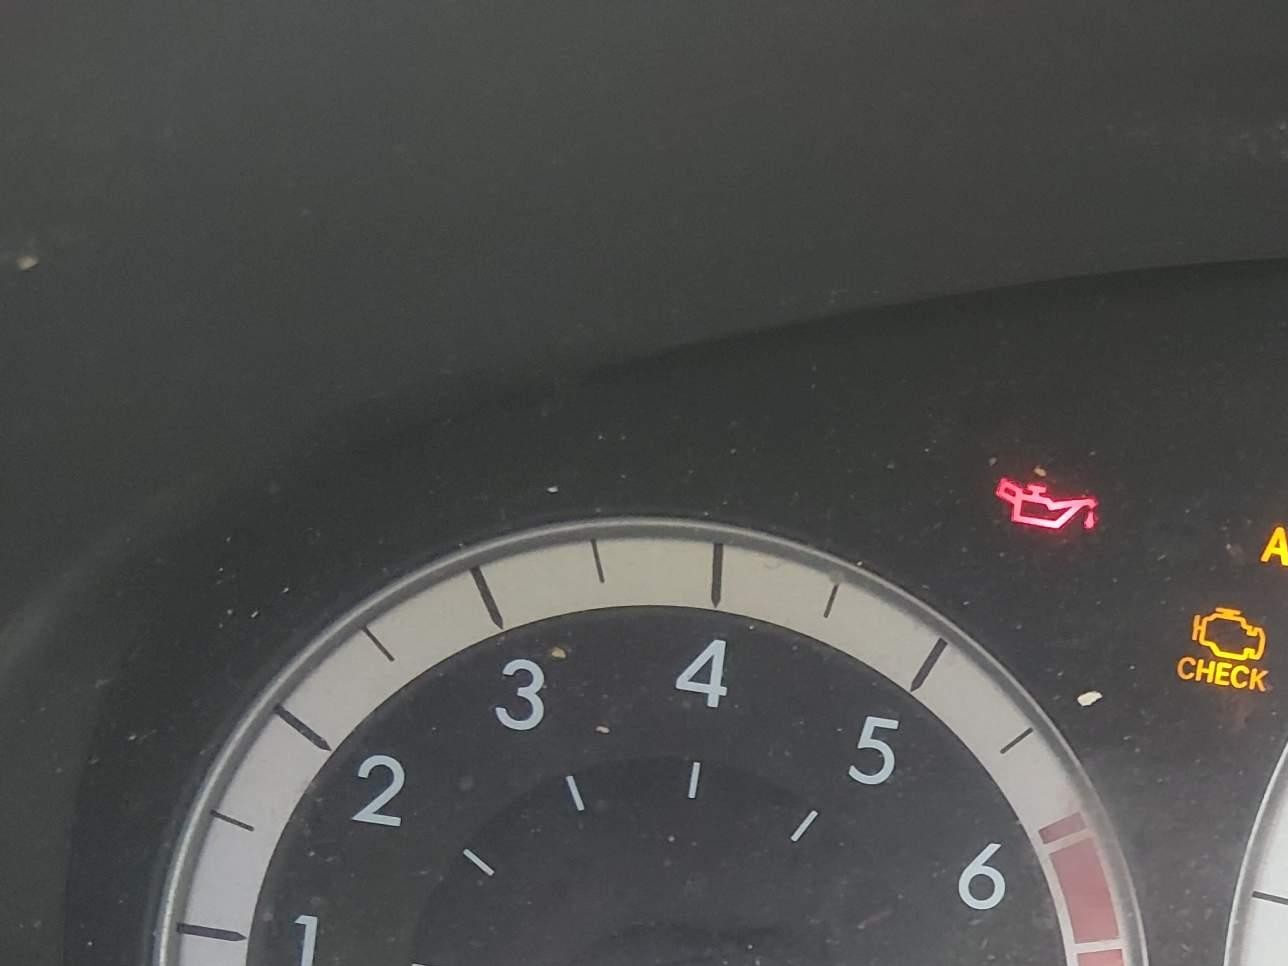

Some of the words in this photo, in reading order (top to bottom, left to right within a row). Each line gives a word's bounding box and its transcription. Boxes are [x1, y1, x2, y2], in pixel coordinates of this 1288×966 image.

[494, 658, 546, 731] 3
[675, 639, 728, 708] 4
[1177, 656, 1270, 692] CHECK
[848, 715, 899, 785] 5
[352, 755, 406, 827] 2
[958, 843, 1006, 910] 6
